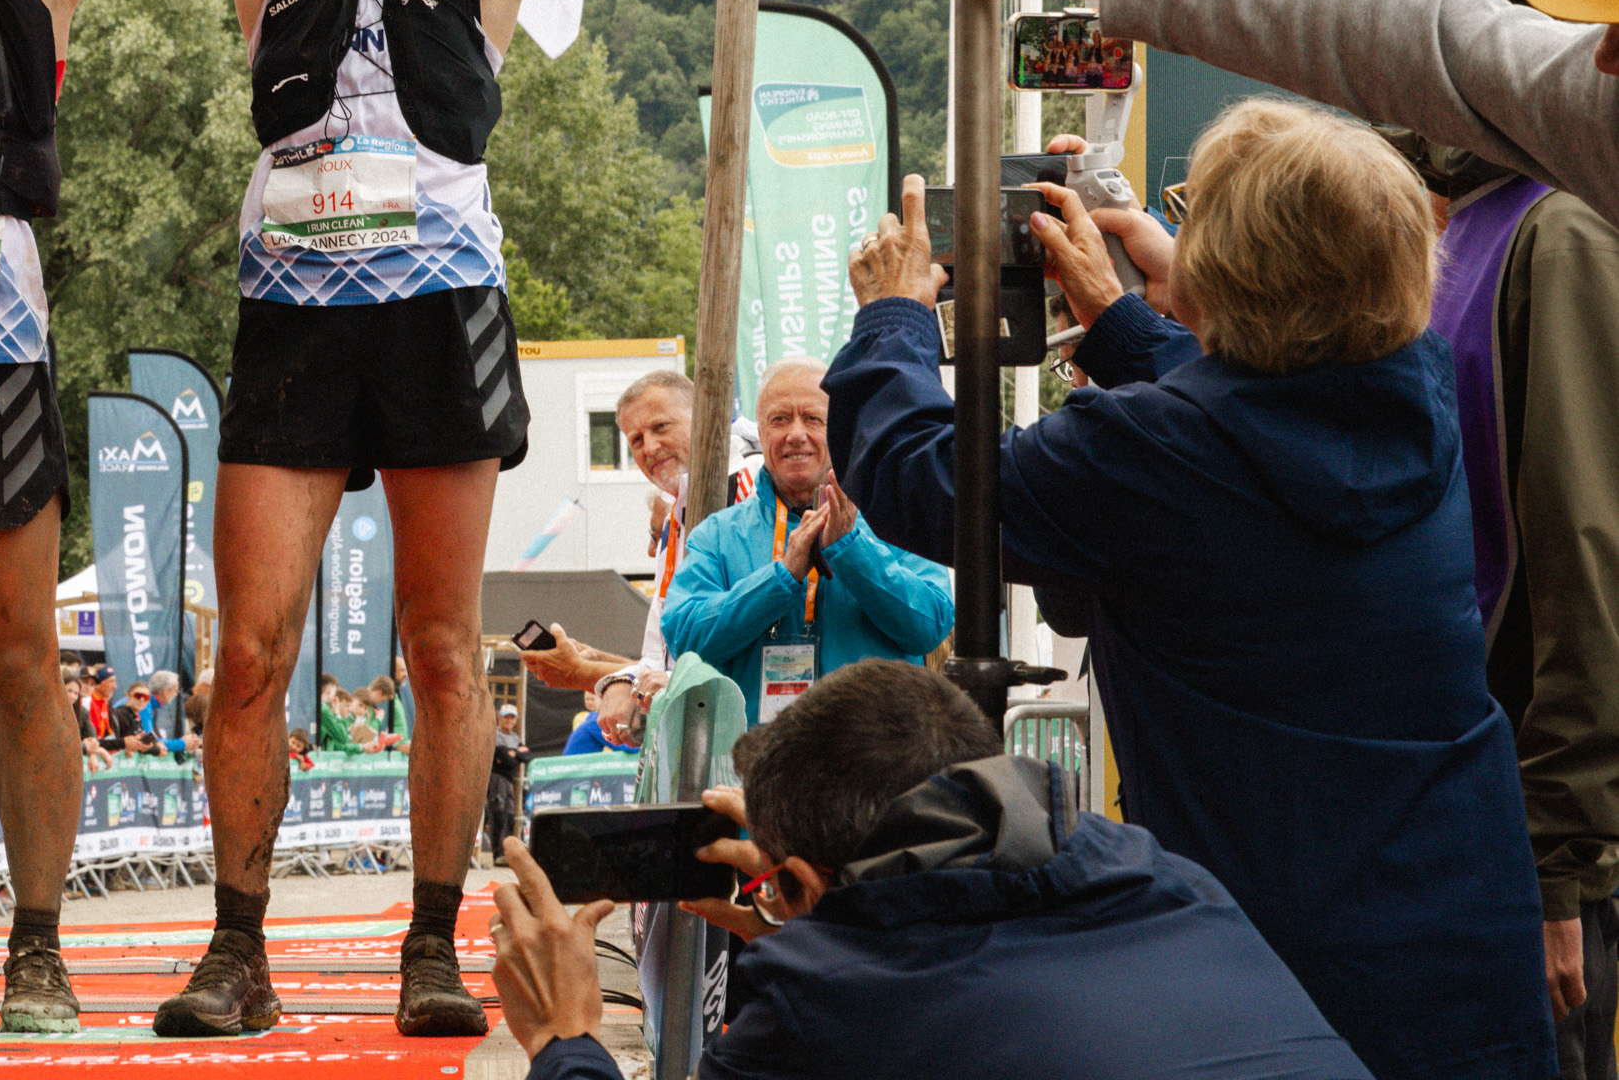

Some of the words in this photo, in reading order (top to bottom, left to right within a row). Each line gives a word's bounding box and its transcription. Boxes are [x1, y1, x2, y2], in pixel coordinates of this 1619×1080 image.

[312, 189, 355, 215] 914
[309, 232, 368, 249] ANNECY
[371, 229, 409, 244] 2024
